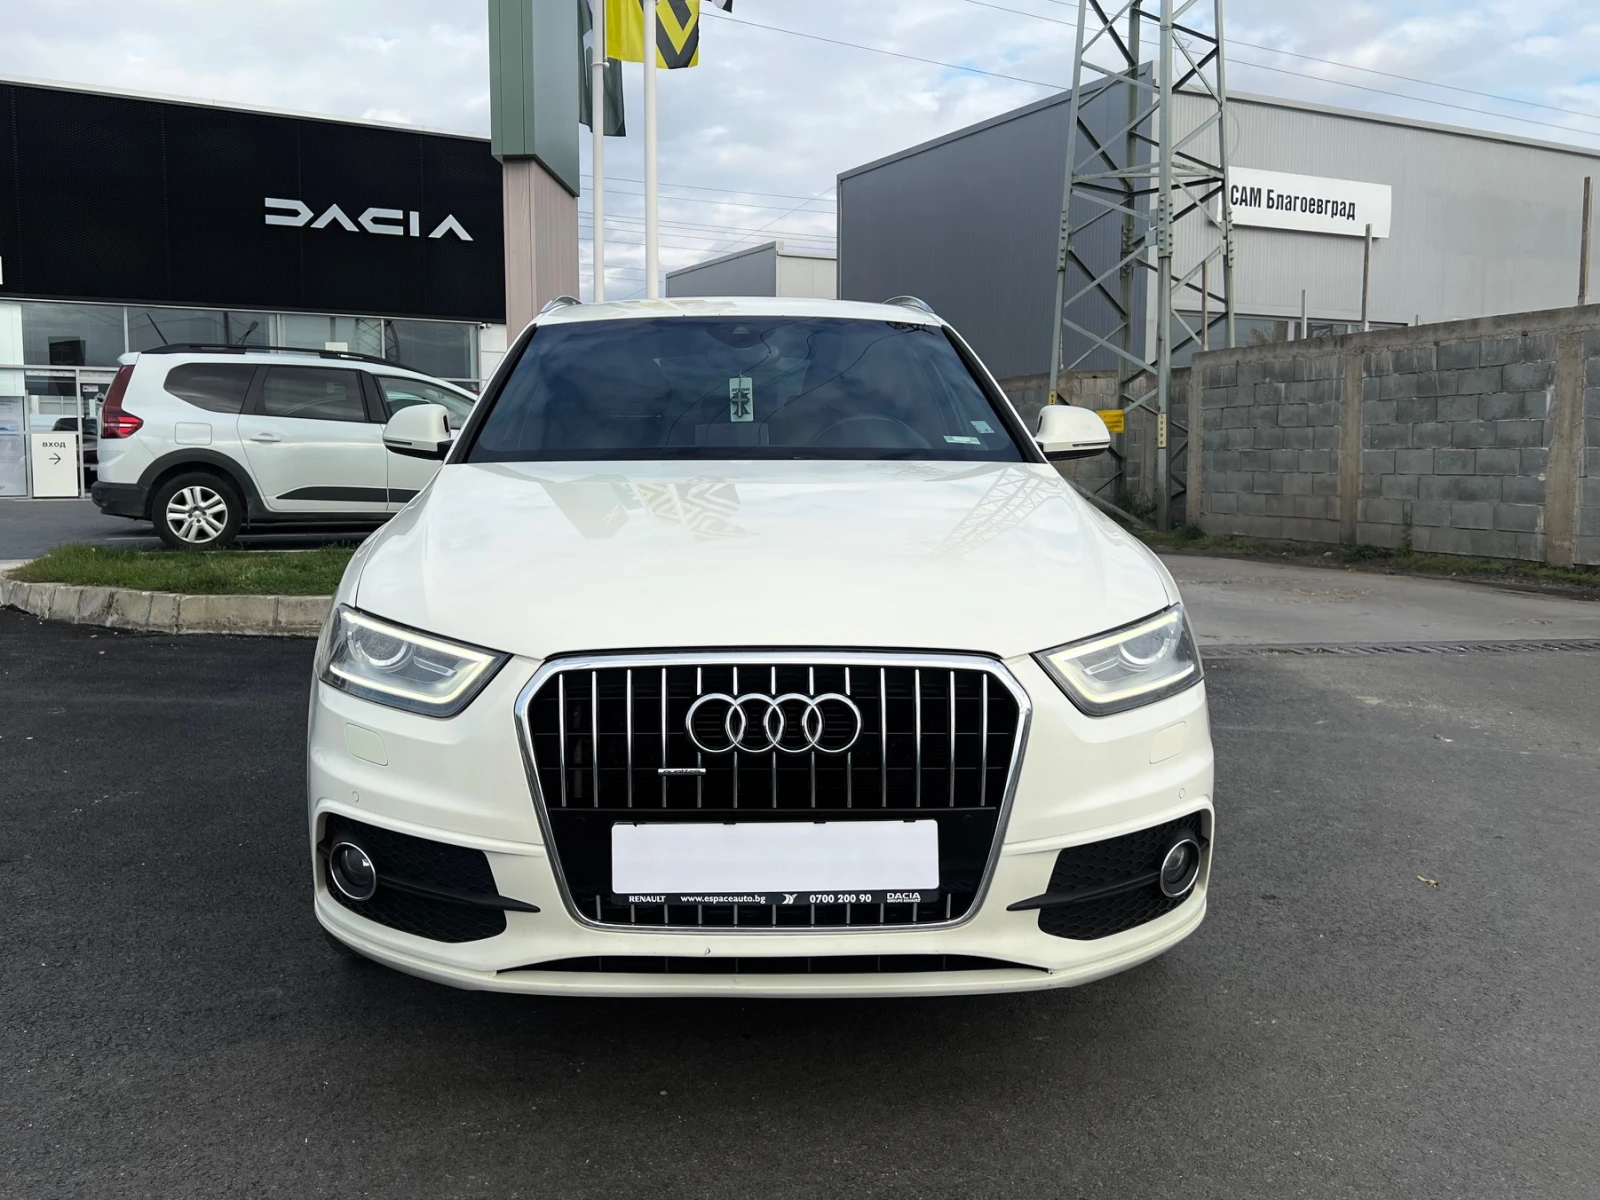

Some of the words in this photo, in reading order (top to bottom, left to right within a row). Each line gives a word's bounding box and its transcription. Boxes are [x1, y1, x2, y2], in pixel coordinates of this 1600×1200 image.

[264, 197, 474, 242] DACIA
[1230, 184, 1262, 208] САМ
[1266, 188, 1356, 220] Благоевград
[628, 895, 666, 903] RENAULT
[680, 894, 766, 904] www.espaceauto.bg
[809, 894, 835, 903] 0700
[837, 894, 856, 903] 200
[858, 893, 872, 903] 90
